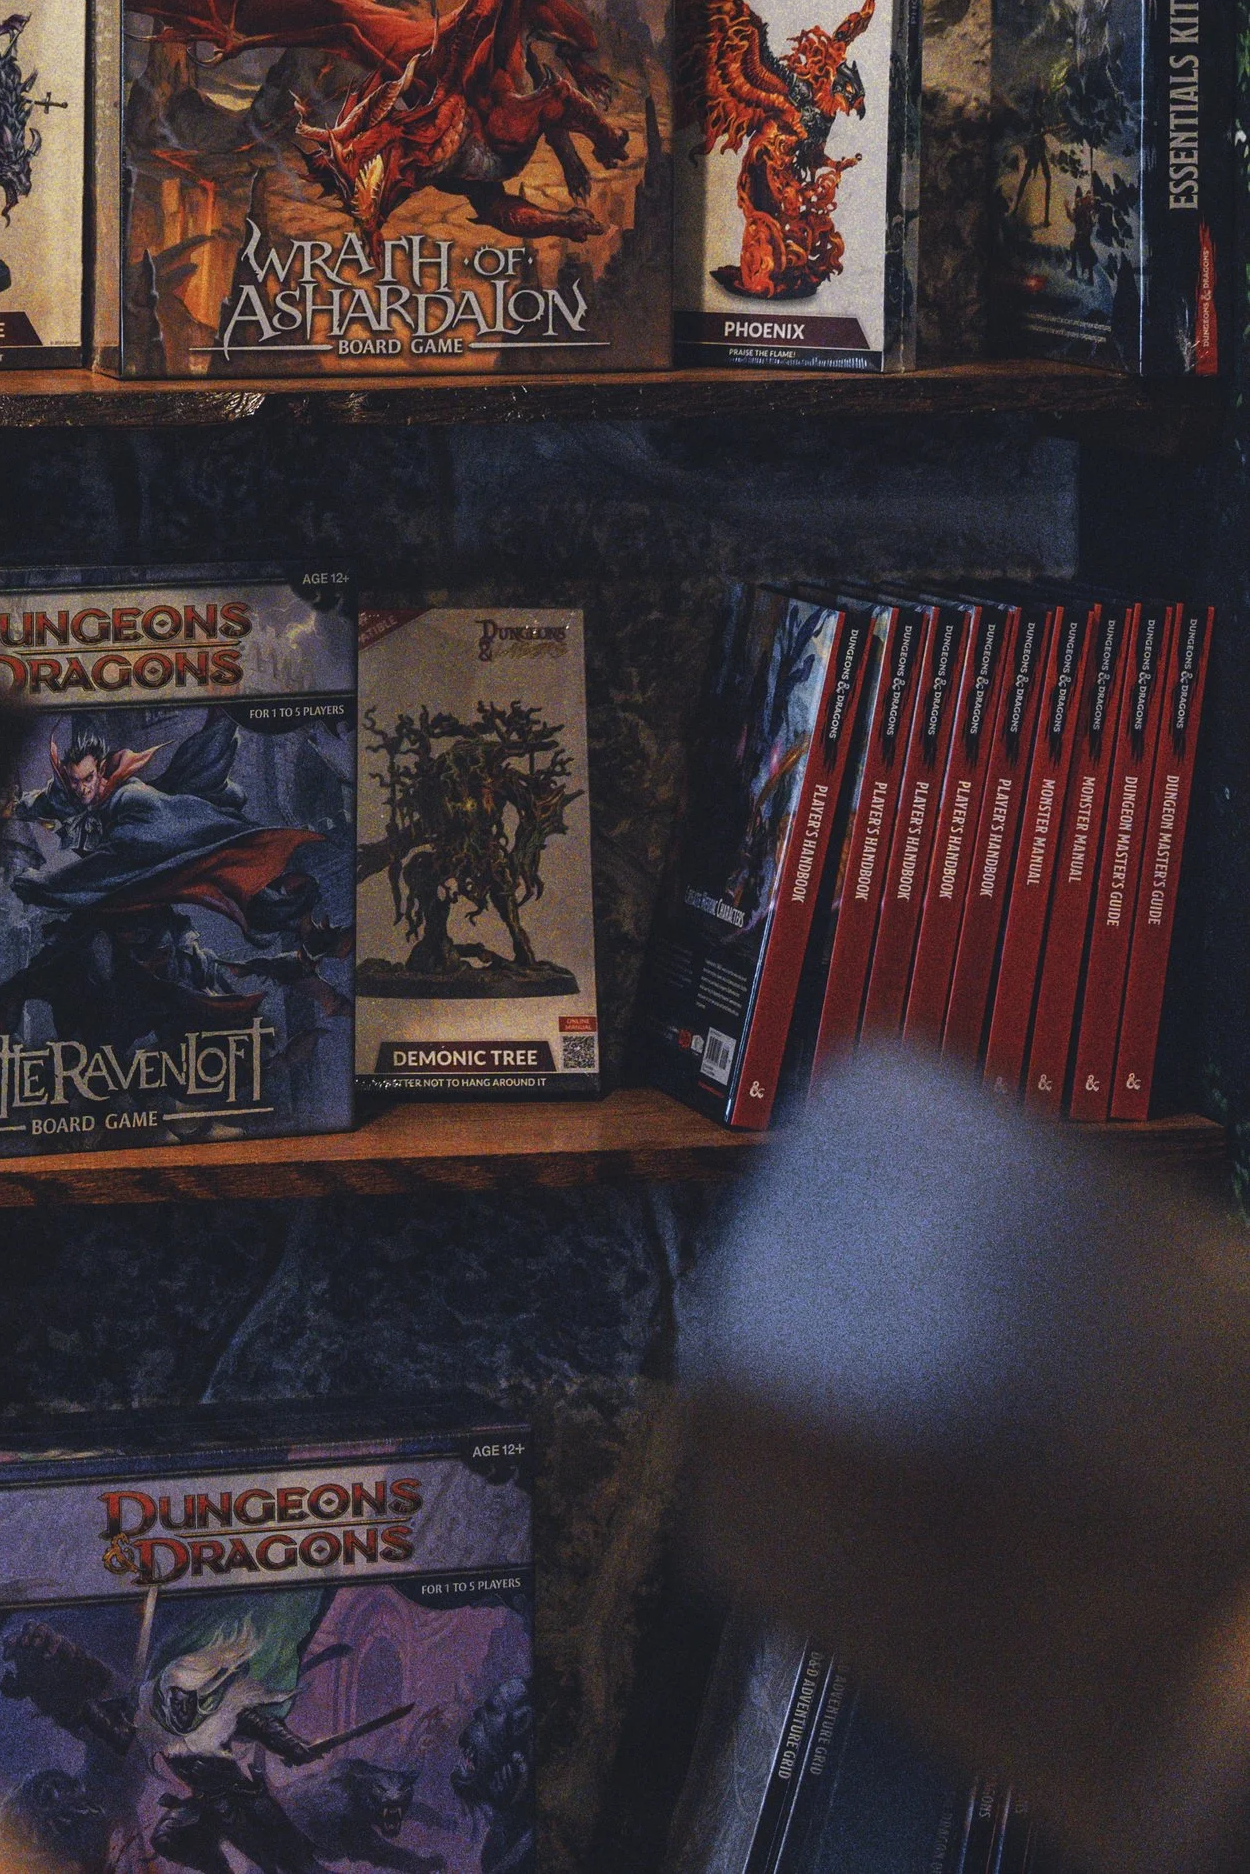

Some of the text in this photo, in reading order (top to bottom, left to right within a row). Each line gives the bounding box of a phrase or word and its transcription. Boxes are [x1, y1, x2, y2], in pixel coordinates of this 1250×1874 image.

[1169, 54, 1199, 210] ESSENTIALS
[241, 218, 526, 292] WRATH OF
[224, 278, 589, 361] ASHARDALON
[724, 321, 805, 340] PHOENIX
[338, 337, 464, 355] BOARD GAME
[729, 348, 797, 359] PRAISE THE FLAME!
[302, 572, 350, 585] AGE 12+
[842, 629, 859, 680] DUNGEONS
[897, 625, 912, 676] DUNGEONS
[980, 624, 995, 675] DUNGEONS
[1184, 618, 1198, 670] DUNGEONS
[249, 704, 345, 719] FOR 1 TO 5 PLAYERS
[829, 695, 845, 739] DRAGONS
[887, 692, 901, 736] DRAGONS
[970, 690, 984, 734] DRAGONS
[1176, 685, 1188, 729] DRAGONS
[792, 784, 828, 903] PLAYER'S HANDBOOK
[855, 782, 887, 902] PLAYER'S HANDBOOK
[897, 782, 929, 902] PLAYER'S HANDBOOK
[939, 781, 971, 899] PLAYER'S HANDBOOK
[980, 779, 1012, 898] PLAYER'S HANDBOOK
[1027, 779, 1055, 885] MONSTER MANUAL
[1068, 776, 1096, 883] MONSTER MANUAL
[1106, 776, 1138, 927] DUNGEON MASTER'S GUIDE
[1148, 775, 1179, 925] DUNGEON MASTER'S GUIDE
[46, 1017, 275, 1107] RAVENLOFT
[393, 1050, 538, 1066] DEMONIC TREE
[423, 1077, 547, 1088] NOT TO HANG AROUND IT
[32, 1111, 158, 1135] BOARD GAME
[472, 1443, 525, 1457] AGE 12+
[98, 1477, 423, 1540] DUNGEONS
[130, 1526, 415, 1587] DRAGONS
[422, 1578, 521, 1594] FOR 1 TO 5 PLAYERS
[786, 1678, 816, 1748] ADVENTURE
[778, 1750, 796, 1780] GRID
[810, 1746, 828, 1776] GRID
